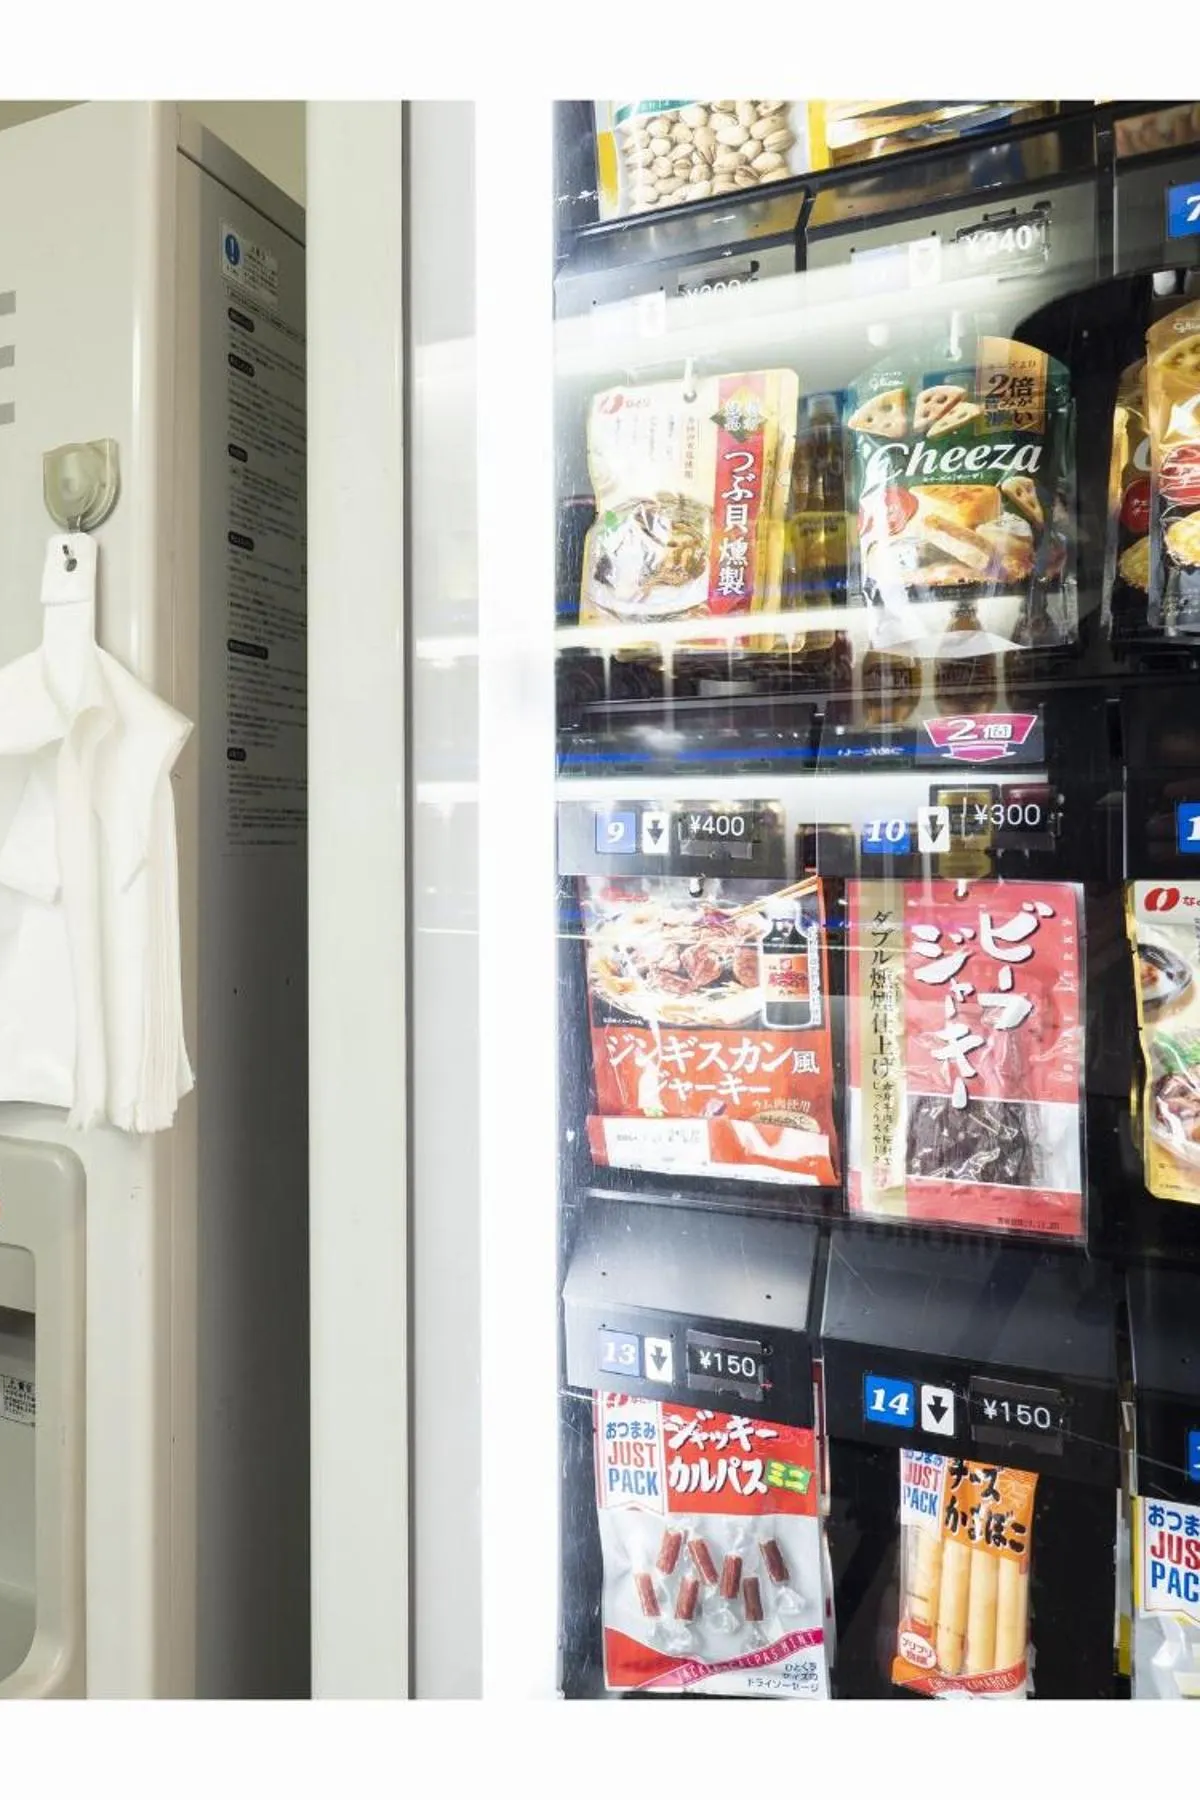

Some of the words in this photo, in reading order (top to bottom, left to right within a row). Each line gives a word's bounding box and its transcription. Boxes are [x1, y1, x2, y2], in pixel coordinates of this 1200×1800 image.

[984, 373, 1035, 399] 2倍
[864, 439, 1044, 486] Cheeza
[945, 718, 1013, 741] 2個
[689, 815, 746, 837] ¥400
[972, 802, 1041, 827] ¥300
[606, 822, 626, 845] 9
[864, 818, 907, 843] 10
[977, 901, 1055, 1031] ビーフ
[911, 924, 986, 1110] ジャーキー
[607, 1034, 820, 1076] ジンギスカン風
[601, 1342, 638, 1366] 13
[699, 1350, 756, 1378] ¥150
[869, 1387, 910, 1416] 14
[983, 1397, 1051, 1430] ¥150
[605, 1421, 657, 1441] おつまみ
[663, 1409, 779, 1452] ジャッキー
[607, 1440, 657, 1469] JUST
[608, 1467, 659, 1497] PACK
[667, 1456, 768, 1497] カルパス
[766, 1461, 807, 1490] ミニ
[903, 1463, 941, 1492] JUST
[903, 1484, 939, 1518] PACK
[1151, 1560, 1200, 1603] PAC
